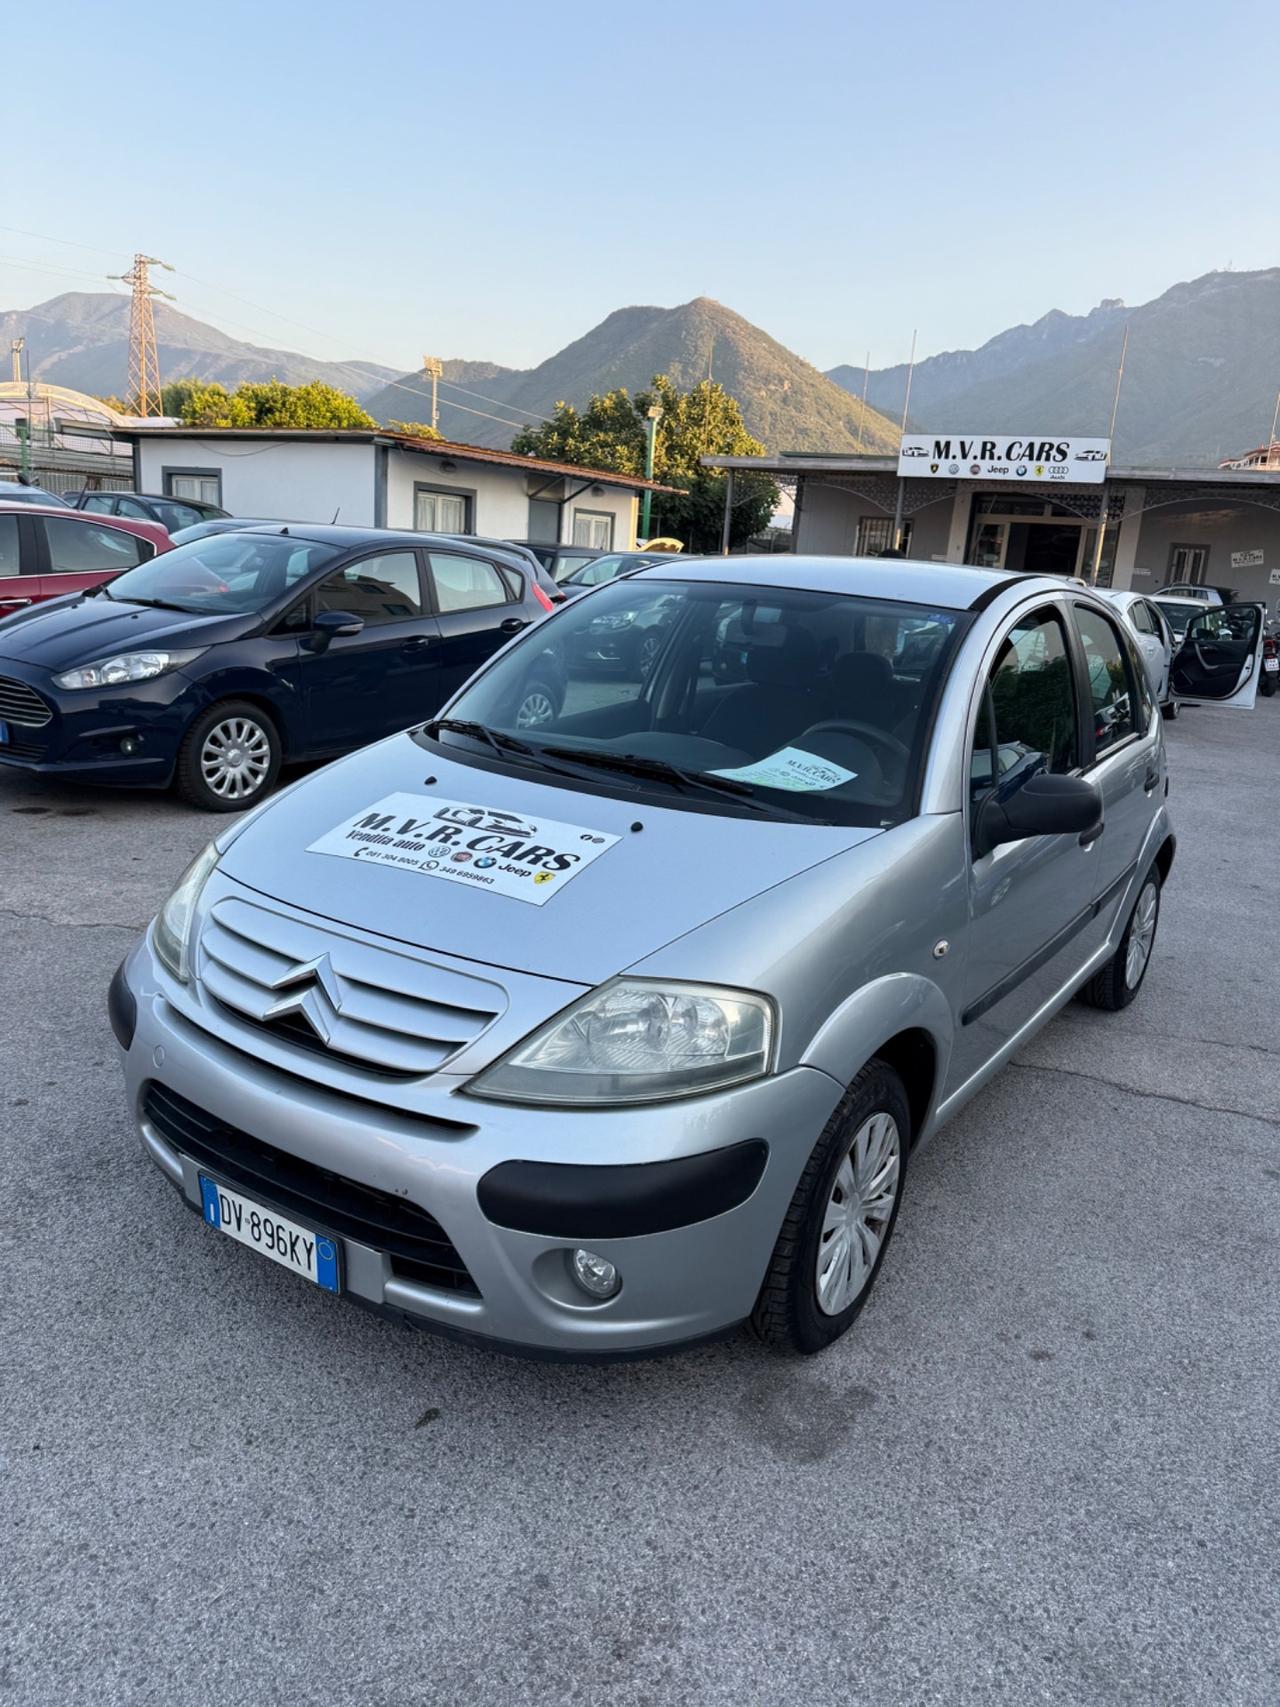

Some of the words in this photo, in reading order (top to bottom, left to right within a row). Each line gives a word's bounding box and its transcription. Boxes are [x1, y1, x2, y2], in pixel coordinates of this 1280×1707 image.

[987, 465, 1009, 475] Jeep
[345, 830, 394, 845] Vendita
[392, 839, 426, 851] auto
[498, 863, 532, 878] Jeep
[219, 1194, 242, 1232] DV
[250, 1211, 314, 1271] 896KY
